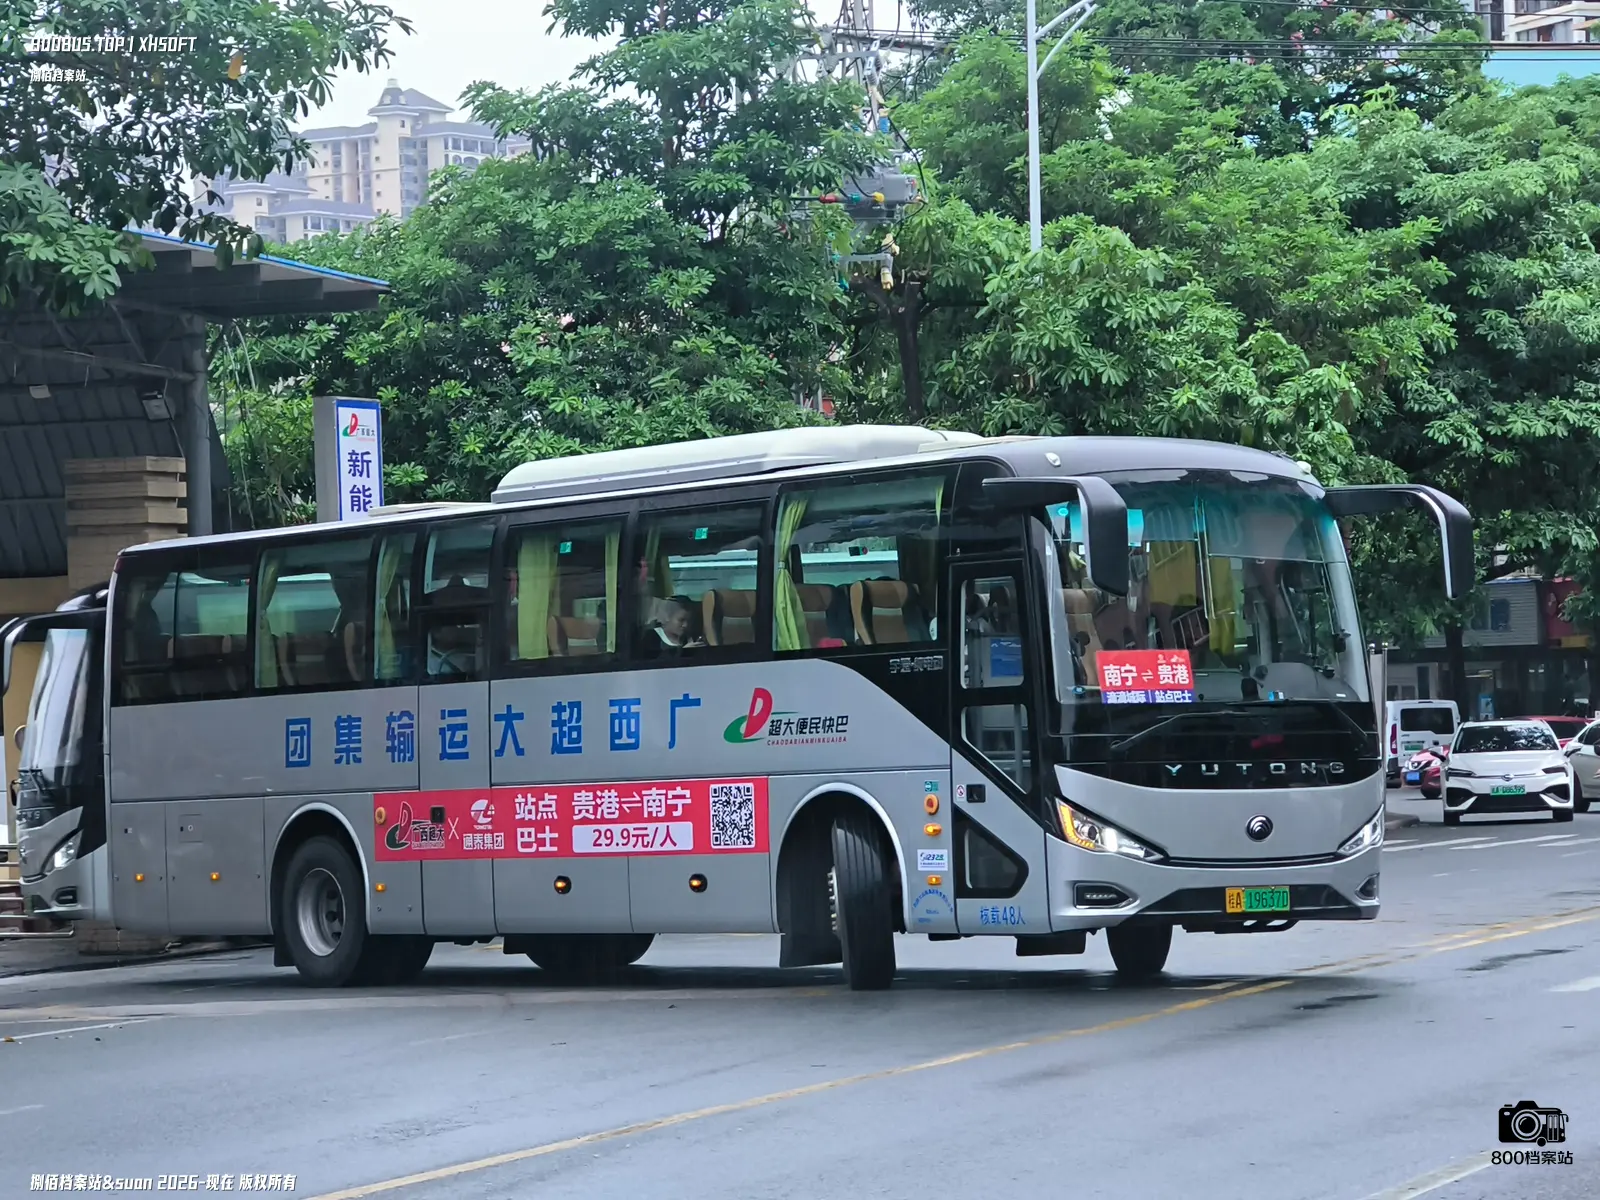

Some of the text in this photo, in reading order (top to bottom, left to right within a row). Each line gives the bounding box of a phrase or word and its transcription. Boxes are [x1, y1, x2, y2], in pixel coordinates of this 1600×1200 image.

[1103, 664, 1189, 686] 南宁 贵港
[1155, 690, 1192, 703] 站点巴士
[768, 715, 849, 737] 超大便民快巴
[1165, 761, 1345, 776] YUTONG
[515, 786, 692, 821] 站点 贵港 南宁
[516, 824, 678, 853] 巴士 29.9元/人
[980, 906, 1026, 926] 核载48人
